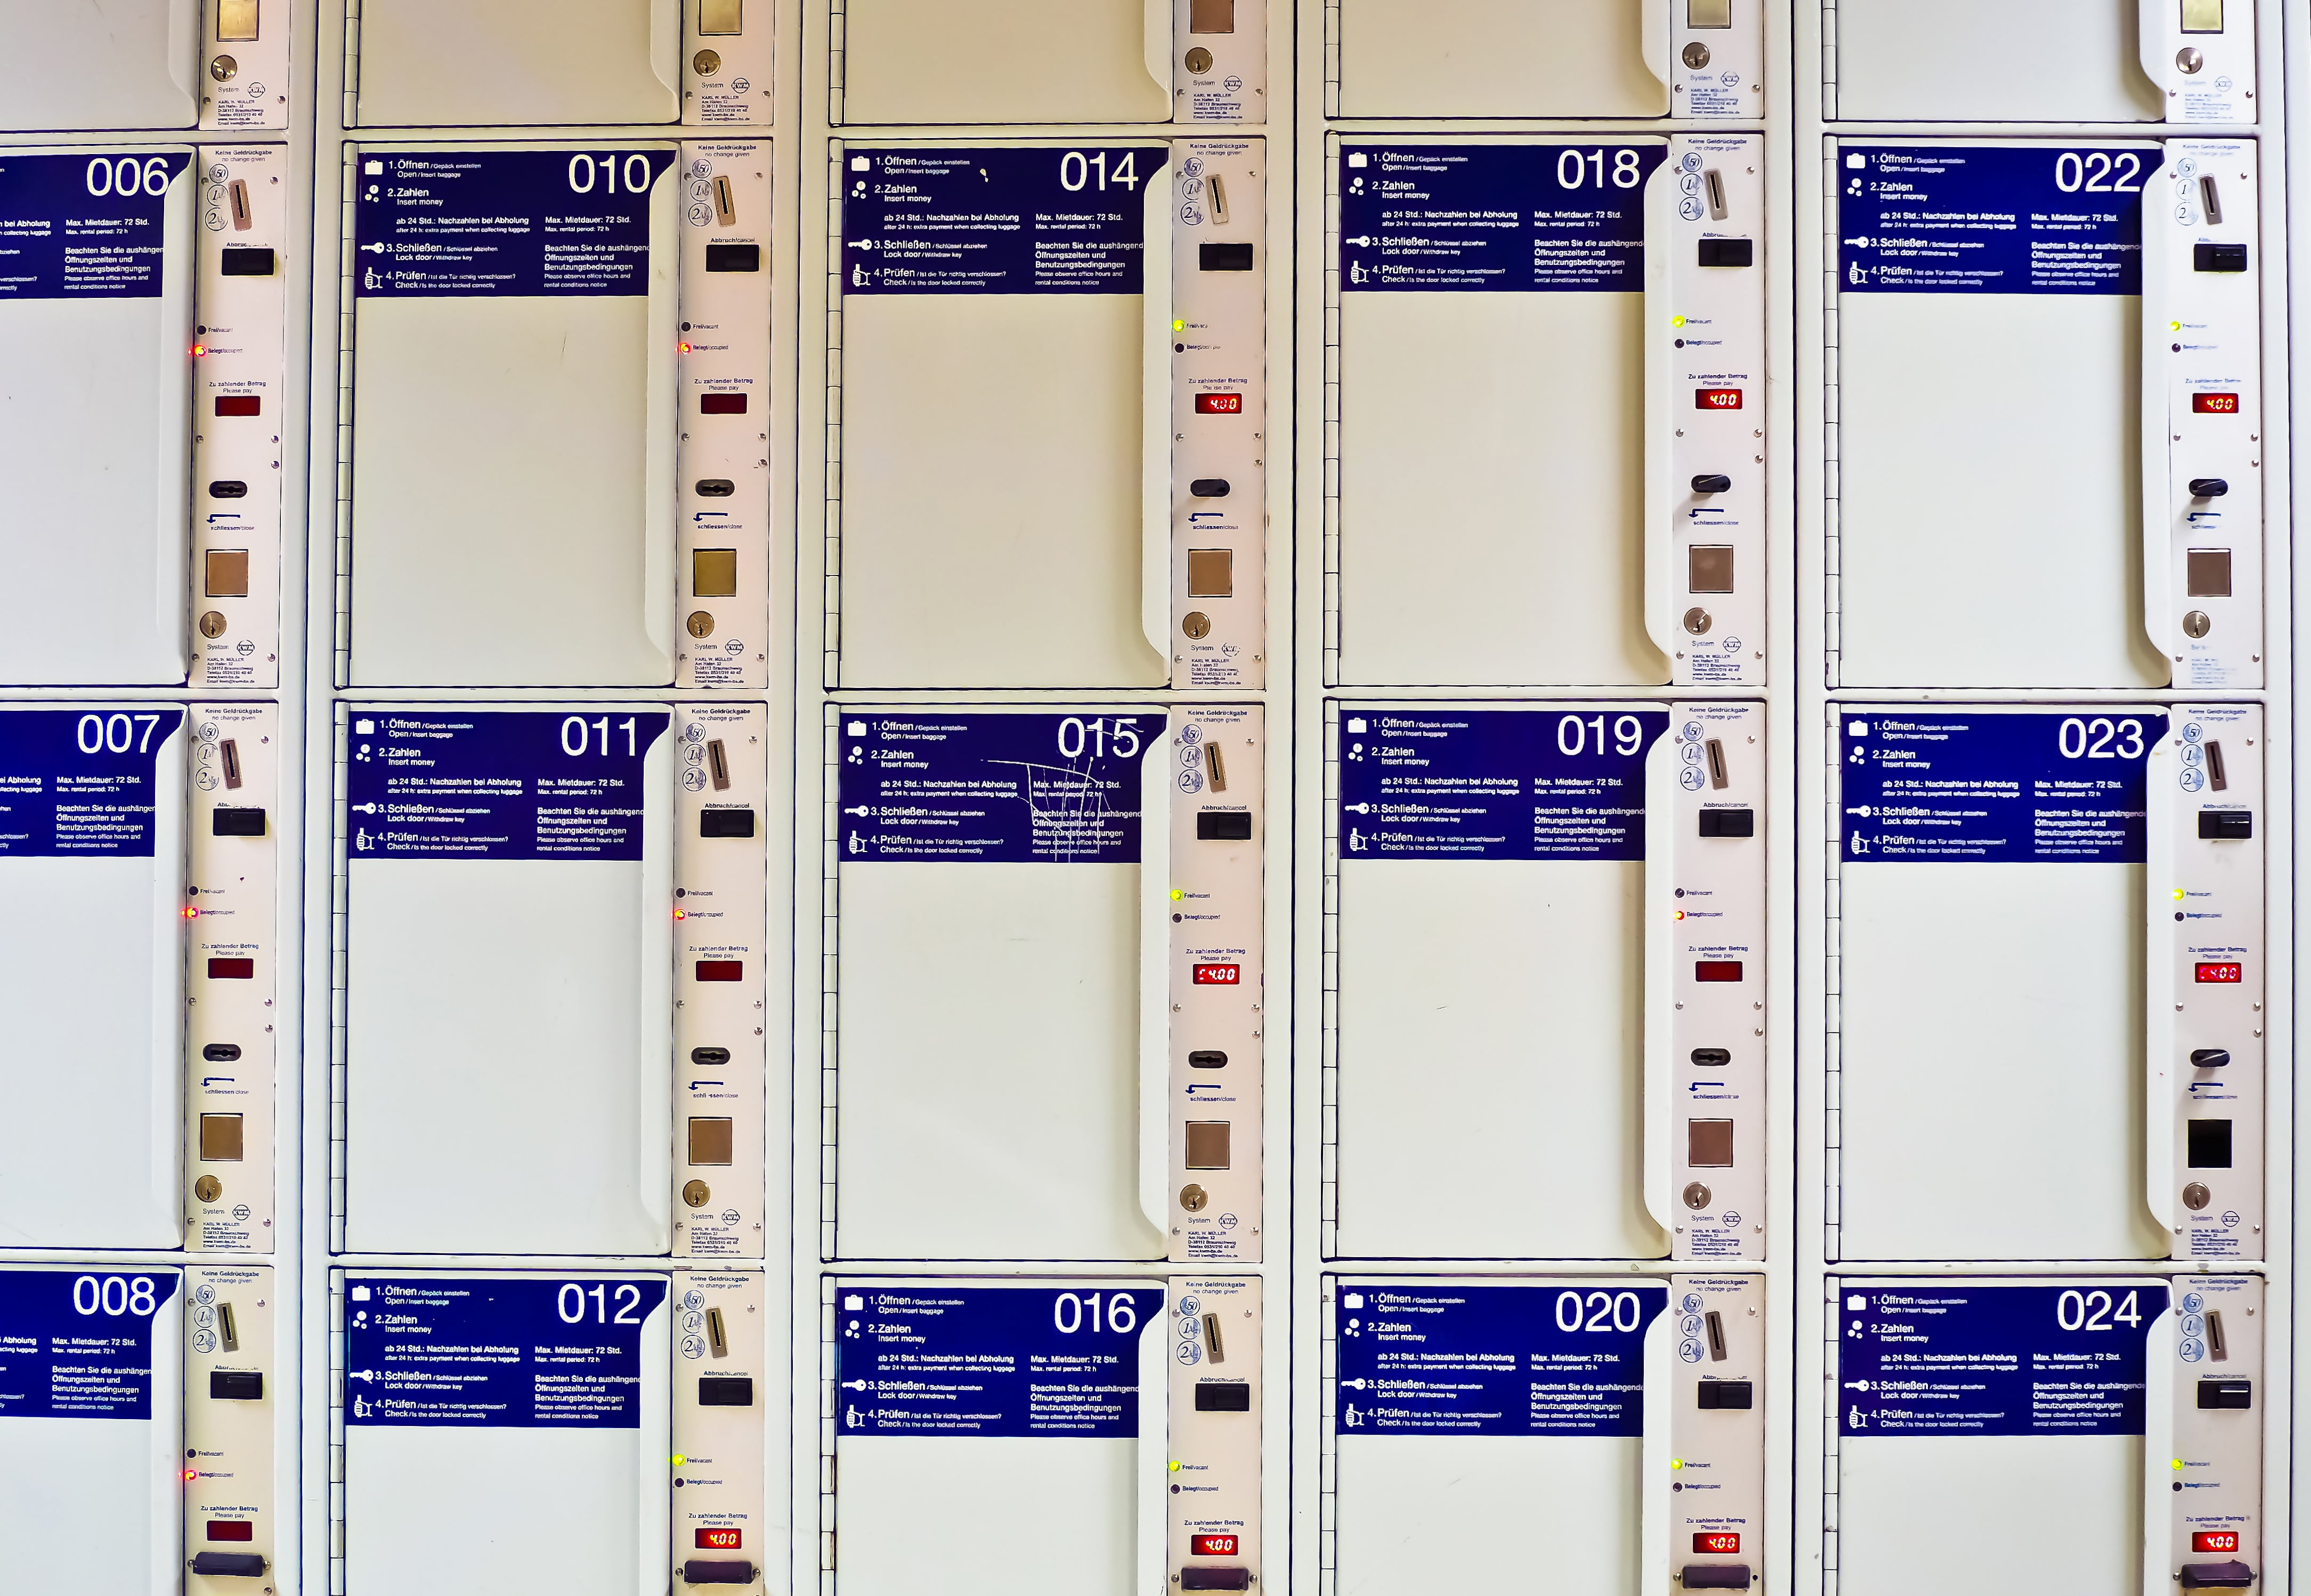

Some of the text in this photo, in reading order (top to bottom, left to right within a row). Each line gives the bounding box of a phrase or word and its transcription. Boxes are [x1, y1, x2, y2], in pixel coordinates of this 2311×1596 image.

[87, 158, 168, 196] 006
[569, 155, 650, 193] 010
[1061, 152, 1138, 191] 014
[1558, 149, 1640, 189] 018
[2056, 153, 2139, 192] 022
[17, 220, 51, 229] Abholung
[1710, 394, 1737, 406] 4.00
[2207, 399, 2233, 409] 4.00
[78, 714, 160, 754] 007
[562, 716, 636, 756] 011
[1058, 717, 1139, 758] 015
[1558, 715, 1642, 756] 019
[2059, 718, 2144, 759] 023
[7, 776, 42, 785] Abholung
[982, 781, 1017, 789] Abholung
[56, 813, 109, 822] Öffnungszeiten
[1535, 816, 1590, 825] Öffnungszeiten
[74, 1276, 156, 1316] 008
[558, 1284, 640, 1324] 012
[1055, 1293, 1136, 1333] 016
[1556, 1291, 1640, 1332] 020
[2057, 1291, 2142, 1330] 024
[1479, 1354, 1514, 1363] Abholung
[535, 1394, 624, 1403] Benutzungsbedingungen
[1531, 1403, 1622, 1411] Benutzungsbedingungen
[710, 1533, 736, 1545] 4.00
[1206, 1539, 1233, 1551] 4.00
[1709, 1537, 1736, 1549] 4.00
[2207, 1536, 2234, 1548] 4.00
